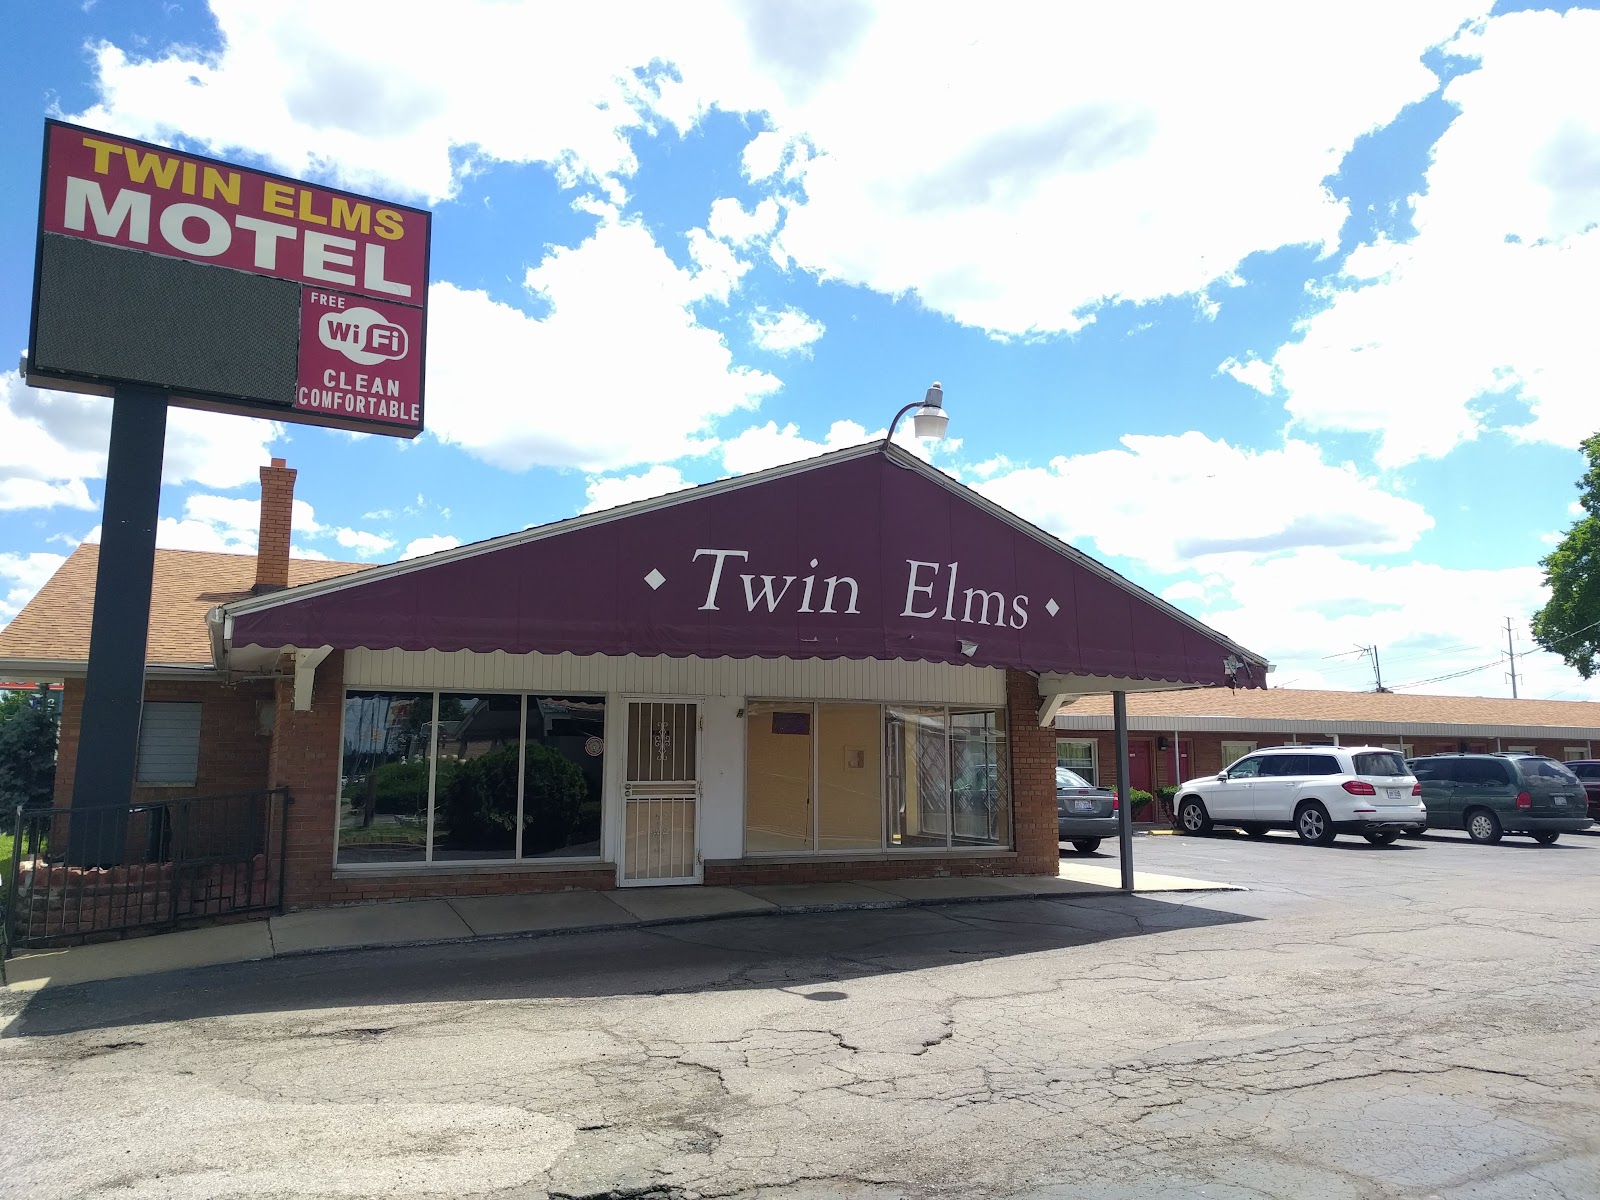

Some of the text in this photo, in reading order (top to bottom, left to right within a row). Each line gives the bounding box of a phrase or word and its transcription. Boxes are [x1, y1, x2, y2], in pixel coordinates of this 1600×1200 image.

[82, 137, 405, 241] TWIN ELMS
[63, 176, 412, 297] MOTEL
[311, 292, 345, 309] FREE
[298, 386, 420, 421] COMFORTABLE
[323, 369, 400, 397] CLEAN
[692, 548, 1030, 630] Twin Elms
